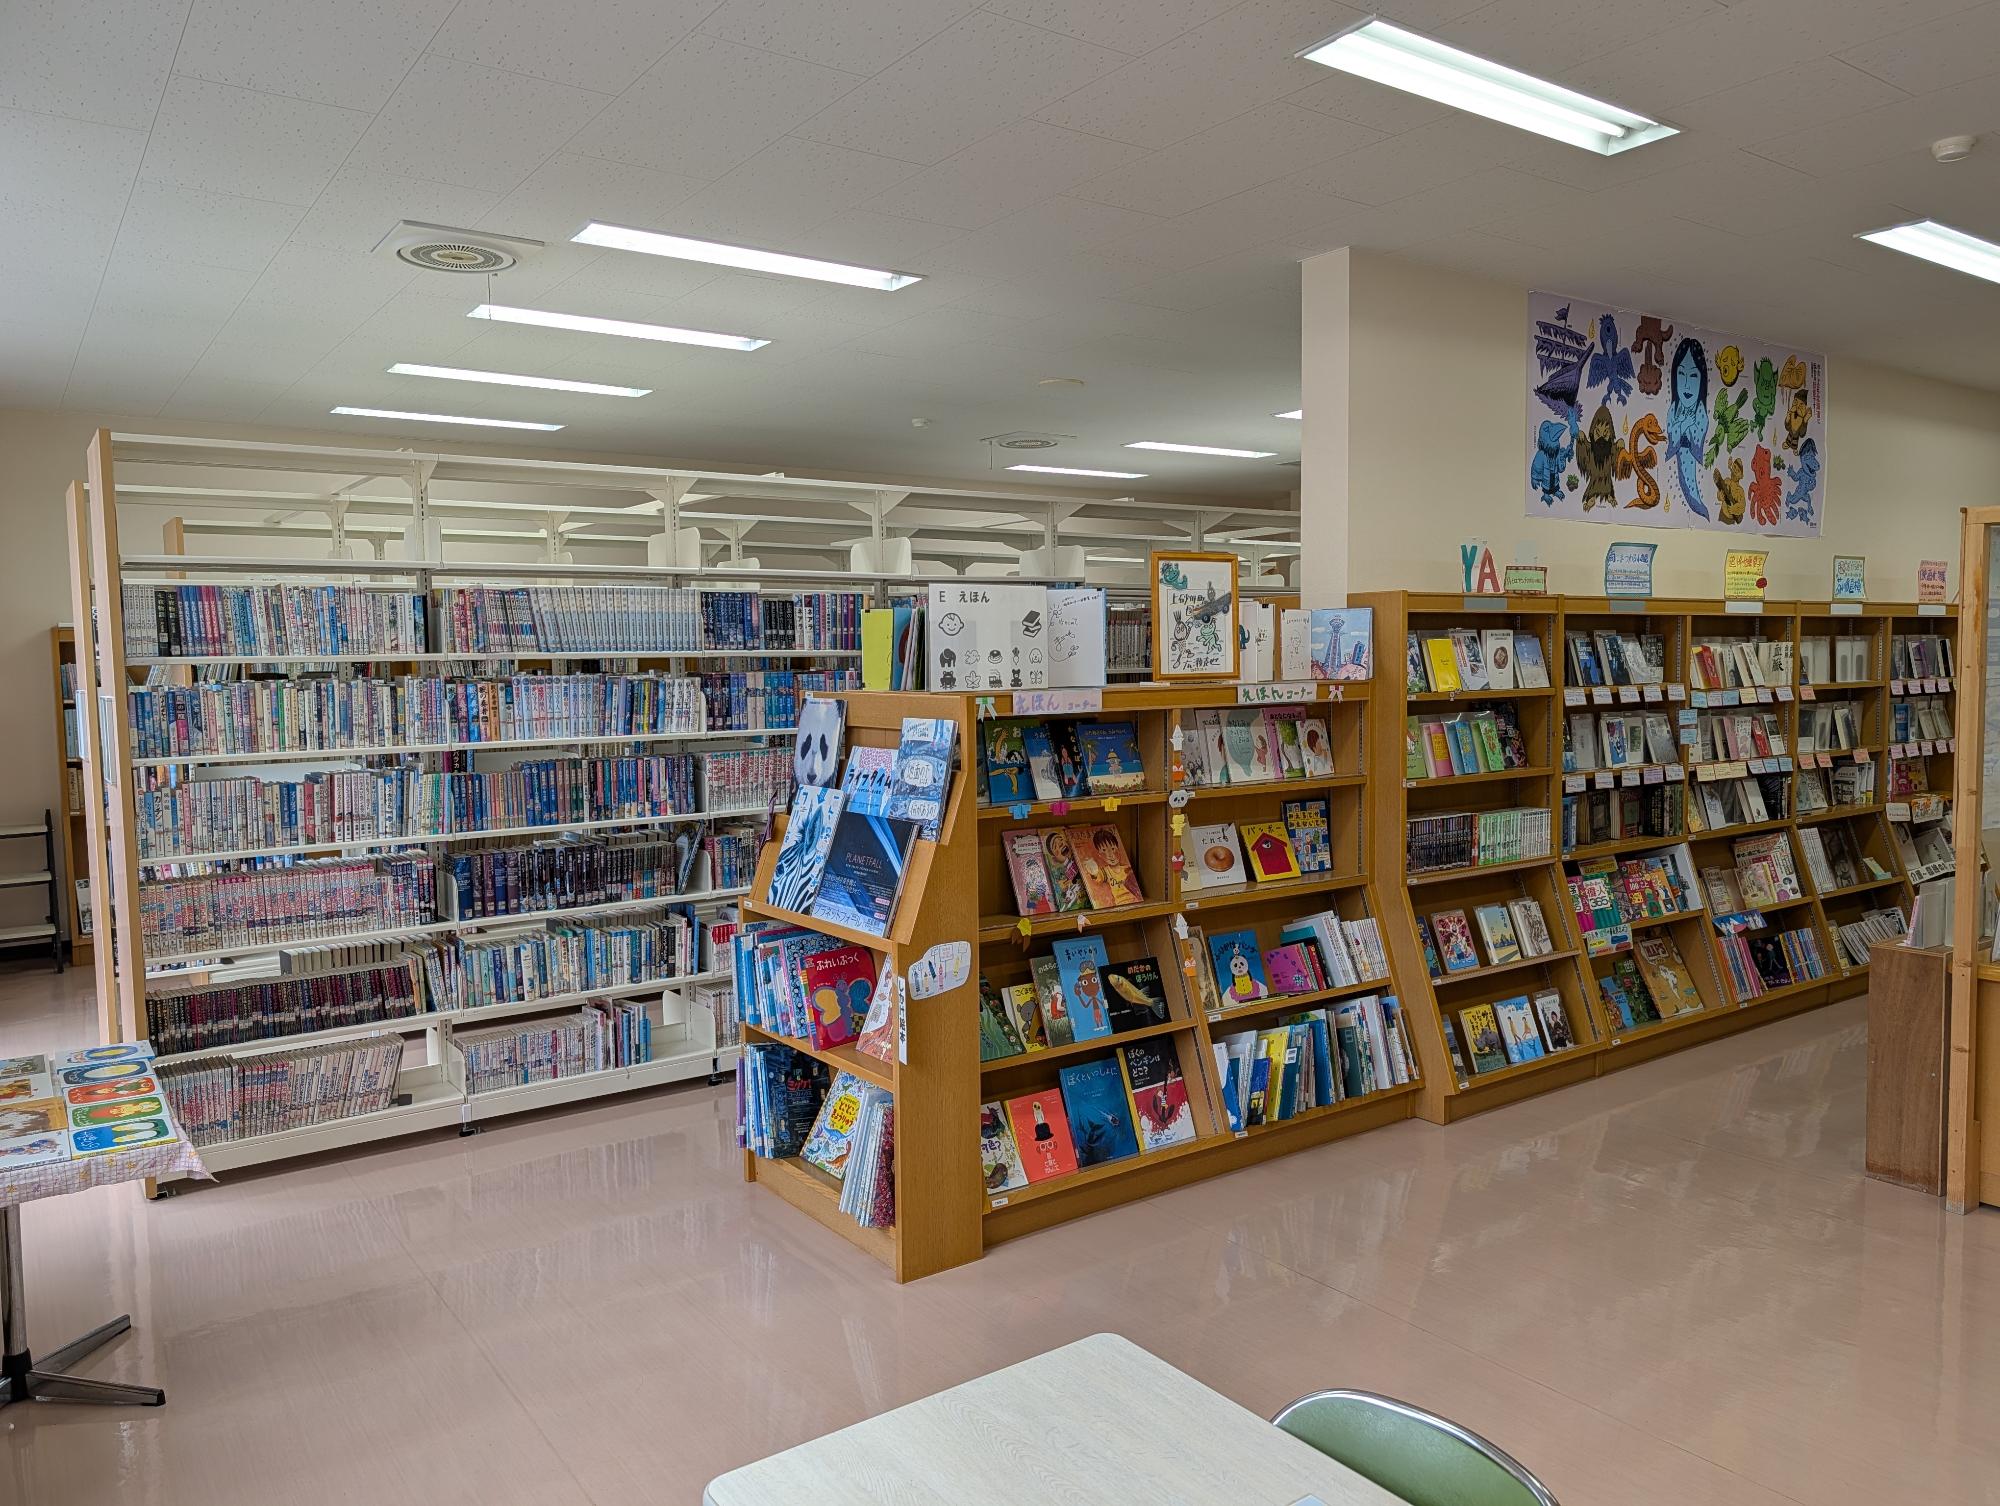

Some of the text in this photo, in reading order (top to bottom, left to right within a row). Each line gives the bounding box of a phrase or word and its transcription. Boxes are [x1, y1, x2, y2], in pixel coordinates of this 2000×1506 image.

[1461, 544, 1501, 593] YA
[940, 590, 990, 603] E えほん
[1242, 687, 1313, 702] えほん コーナー
[1016, 694, 1098, 713] えほん コーナー
[847, 767, 892, 789] ライフタイム
[846, 852, 883, 869] PLANETFALL
[1127, 964, 1151, 975] めだかの
[1128, 1048, 1145, 1059] ぼくの
[1130, 1055, 1161, 1067] ペンギンは
[1067, 1066, 1118, 1086] ぼくといっしょに
[1132, 1066, 1149, 1078] どこ?
